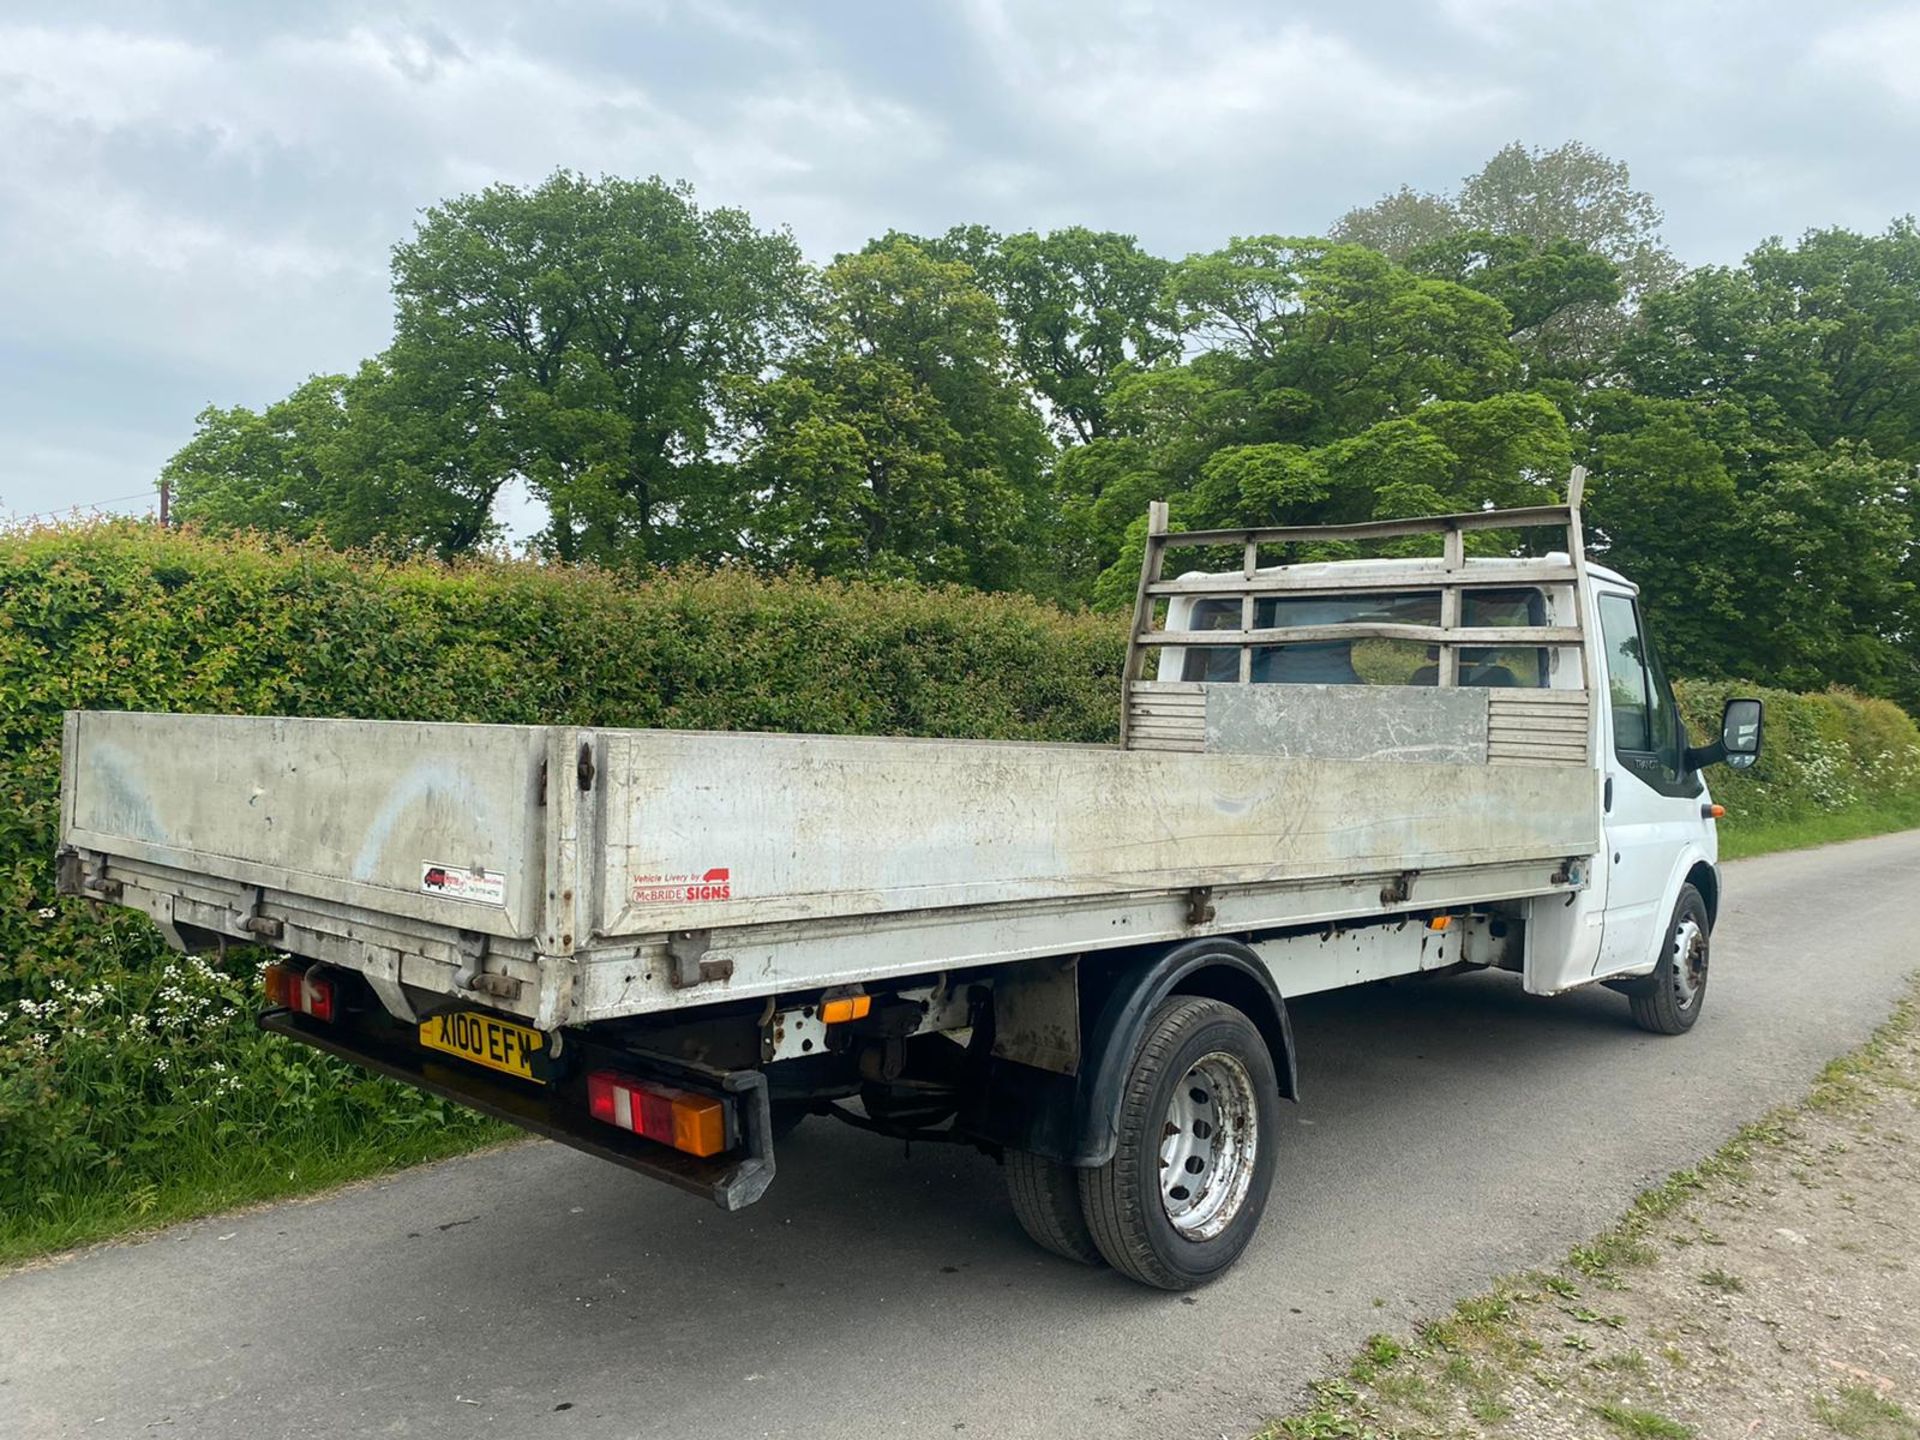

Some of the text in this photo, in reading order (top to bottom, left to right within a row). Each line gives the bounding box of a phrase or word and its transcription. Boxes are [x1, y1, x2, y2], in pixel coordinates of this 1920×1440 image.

[633, 873, 701, 882] Vehicle Livery by
[635, 885, 730, 901] McBRIDE SIGNS
[440, 1013, 482, 1055] X100
